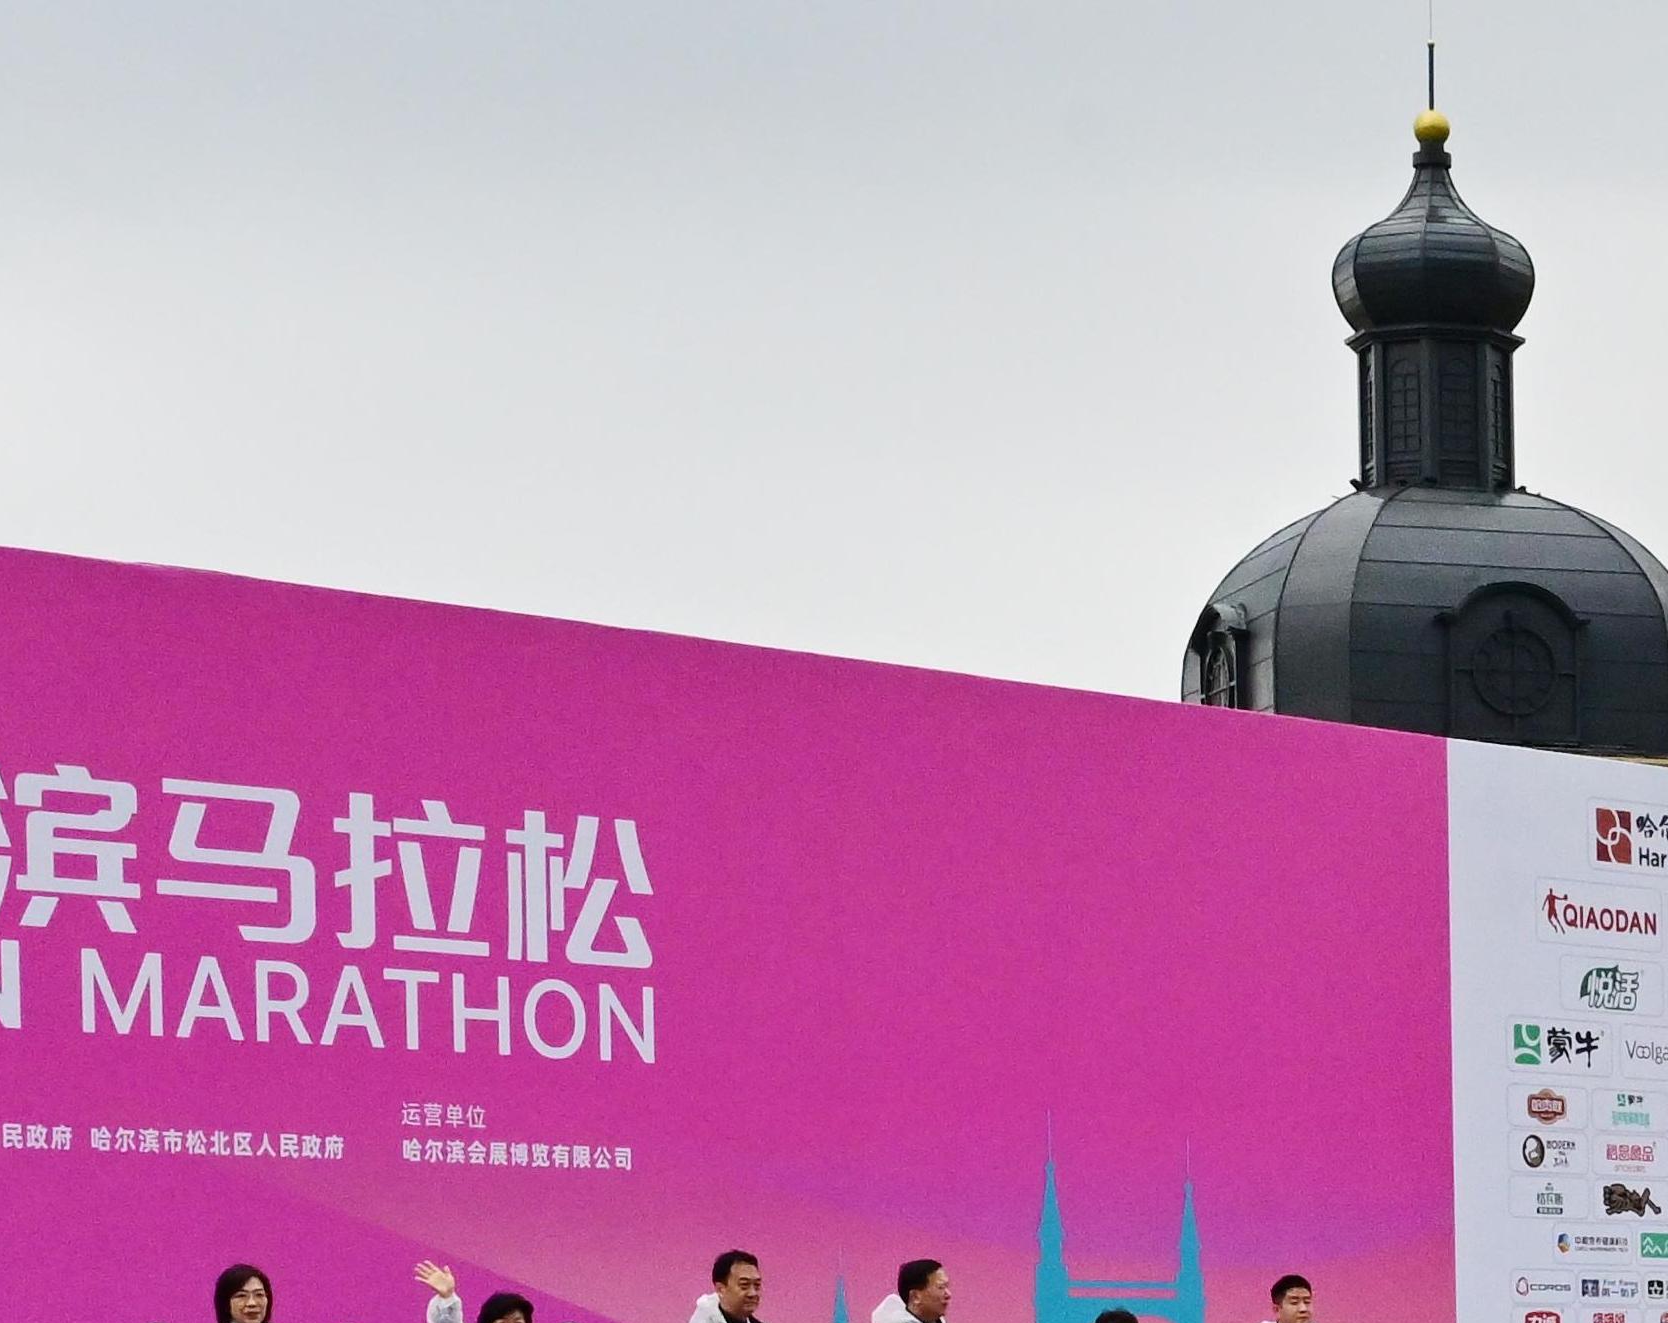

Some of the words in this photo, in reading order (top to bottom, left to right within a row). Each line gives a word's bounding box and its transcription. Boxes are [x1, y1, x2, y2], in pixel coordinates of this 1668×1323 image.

[1563, 903, 1657, 936] QIAODAN
[81, 947, 656, 1064] MARATHON
[1547, 1026, 1600, 1069] 蒙牛
[401, 1101, 488, 1131] 运营单位
[90, 1125, 345, 1161] 哈尔滨市松北区人民政府
[402, 1136, 634, 1172] 哈尔滨会展博览有限公司
